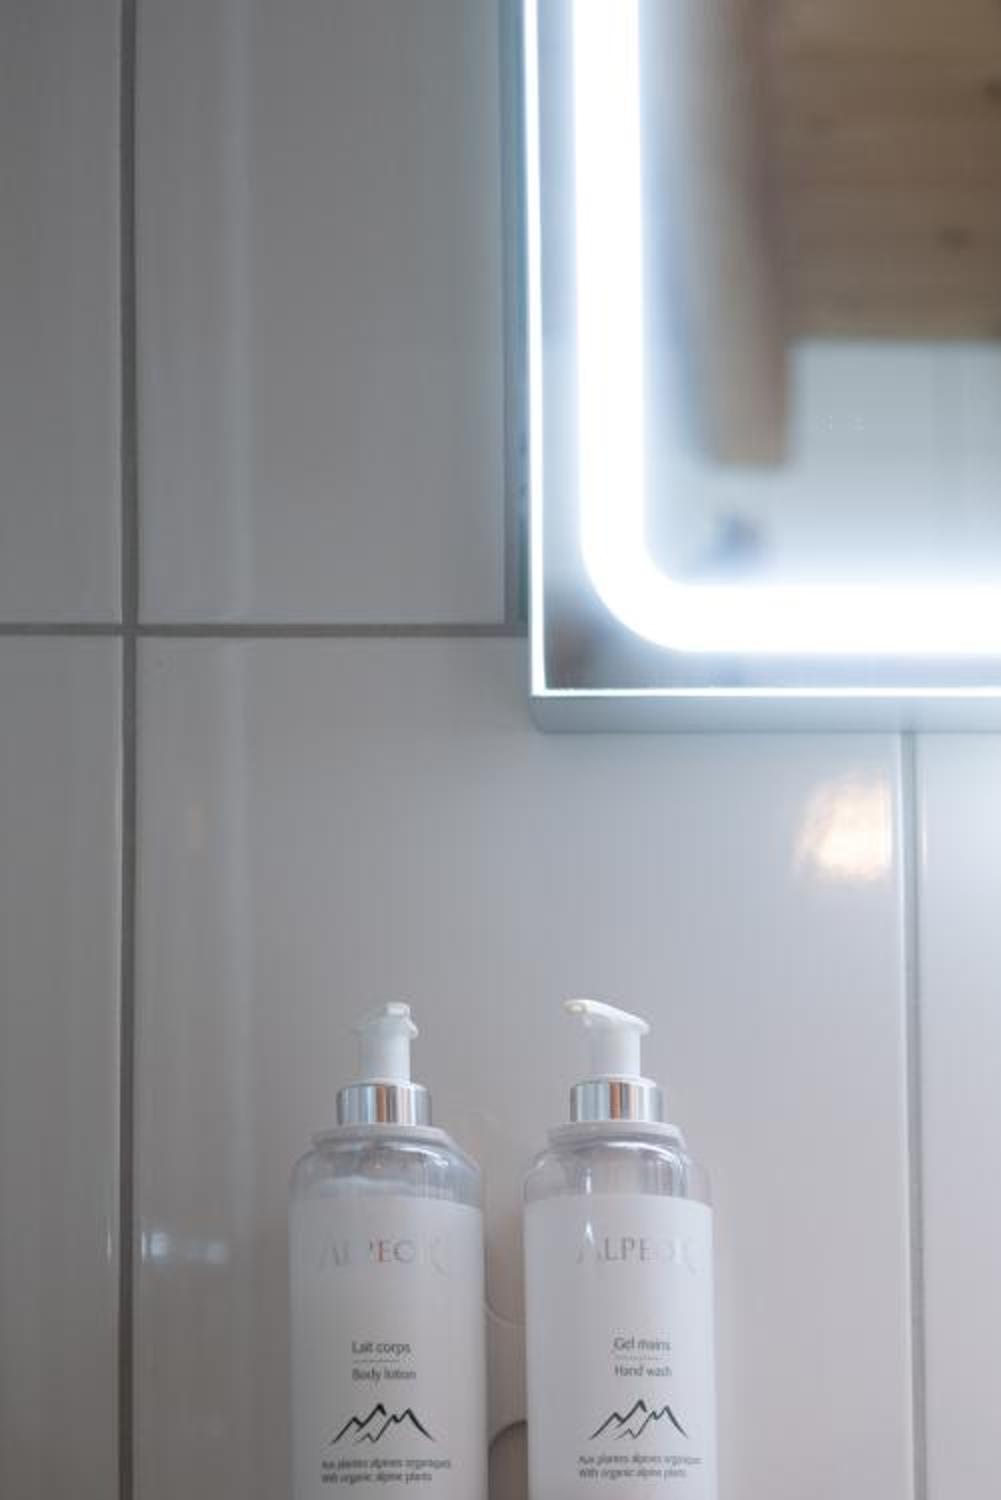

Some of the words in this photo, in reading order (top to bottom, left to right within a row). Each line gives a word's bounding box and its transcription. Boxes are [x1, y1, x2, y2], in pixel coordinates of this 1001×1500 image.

[352, 1341, 373, 1354] Lait
[376, 1343, 412, 1357] corps
[613, 1336, 634, 1350] Gel
[352, 1367, 381, 1383] Body
[614, 1365, 643, 1377] Hand
